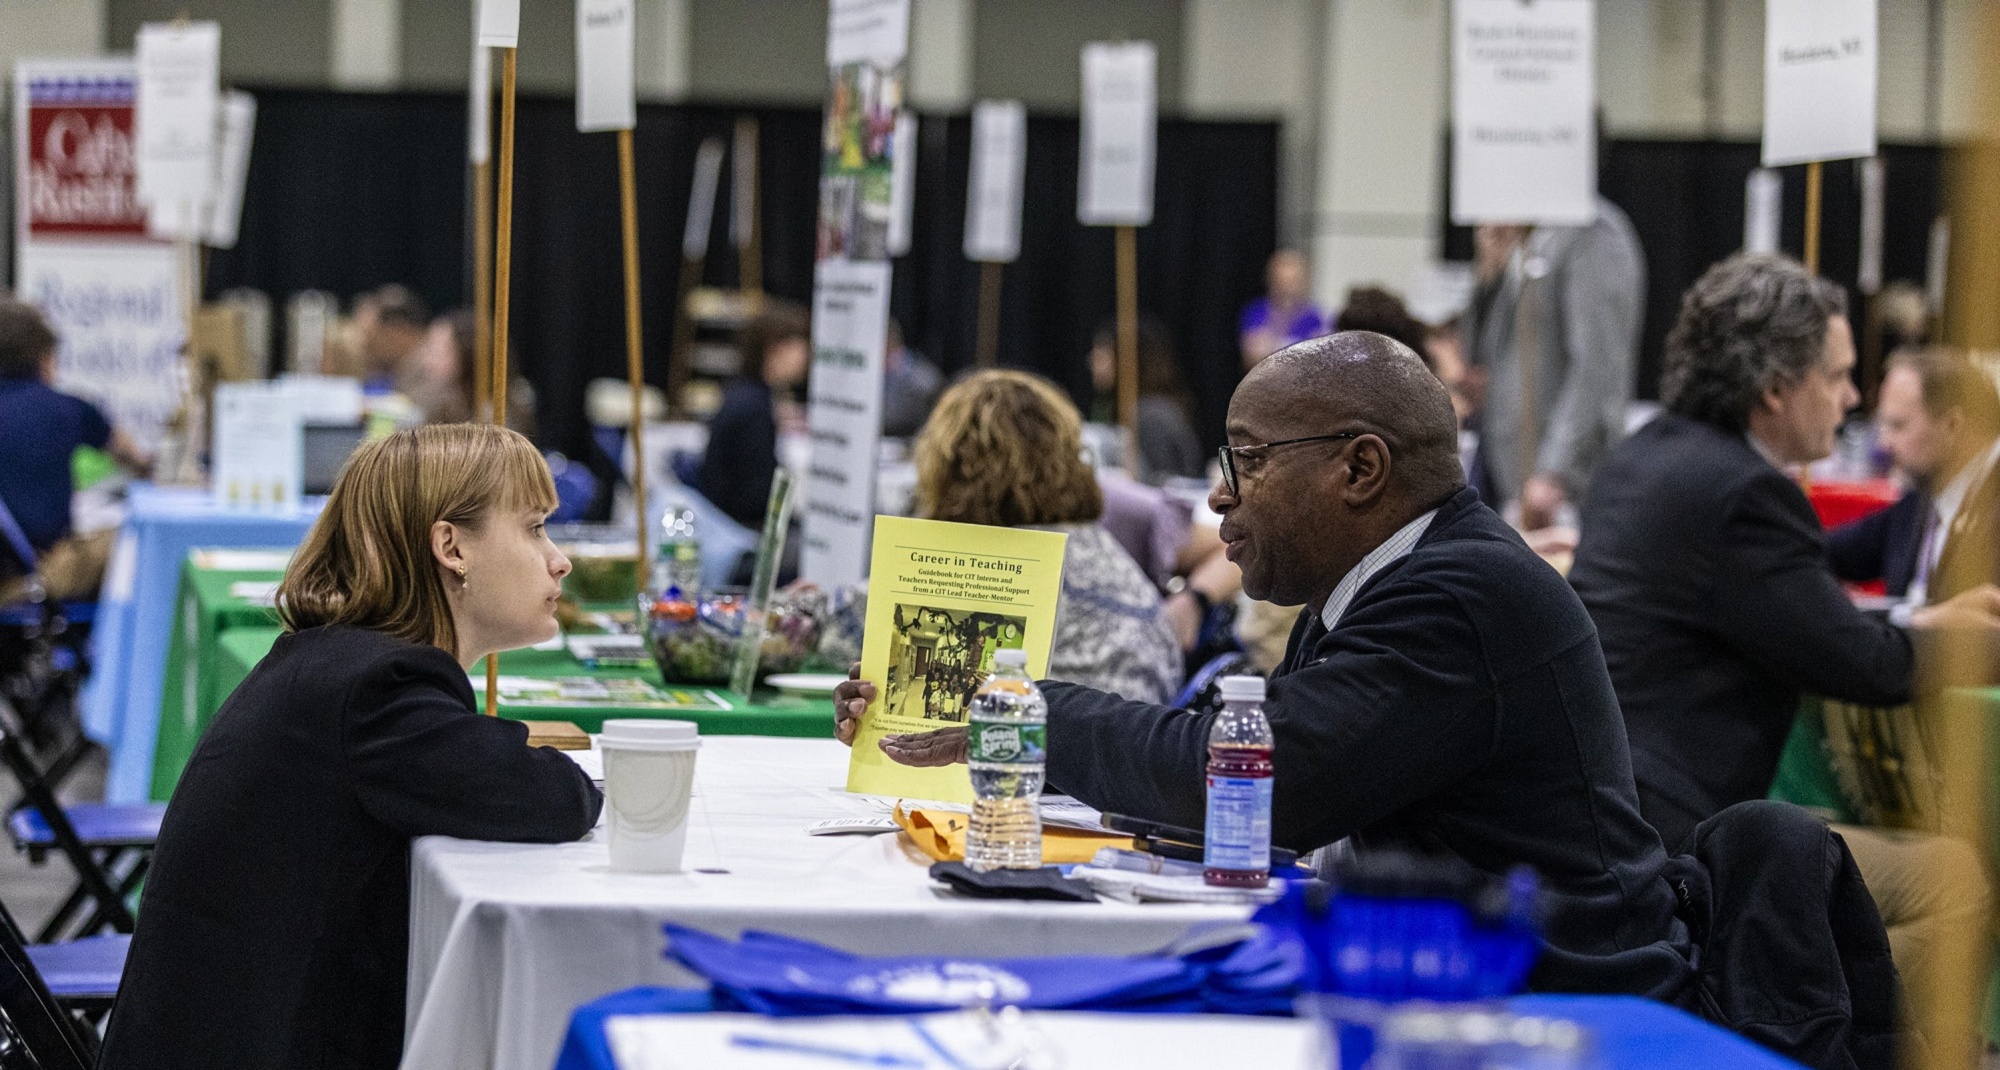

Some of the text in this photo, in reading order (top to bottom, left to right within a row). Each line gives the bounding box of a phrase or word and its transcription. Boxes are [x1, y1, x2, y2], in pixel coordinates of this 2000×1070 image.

[910, 552, 1023, 574] Career in Teaching
[918, 569, 953, 578] Guidebook
[977, 574, 999, 583] Interns
[898, 575, 1030, 595] Teachers Requesting Professional Support
[947, 589, 963, 597] Lead
[964, 591, 1014, 602] Teacher-Mentor
[981, 727, 1019, 743] Poland
[982, 740, 1020, 757] Spring
